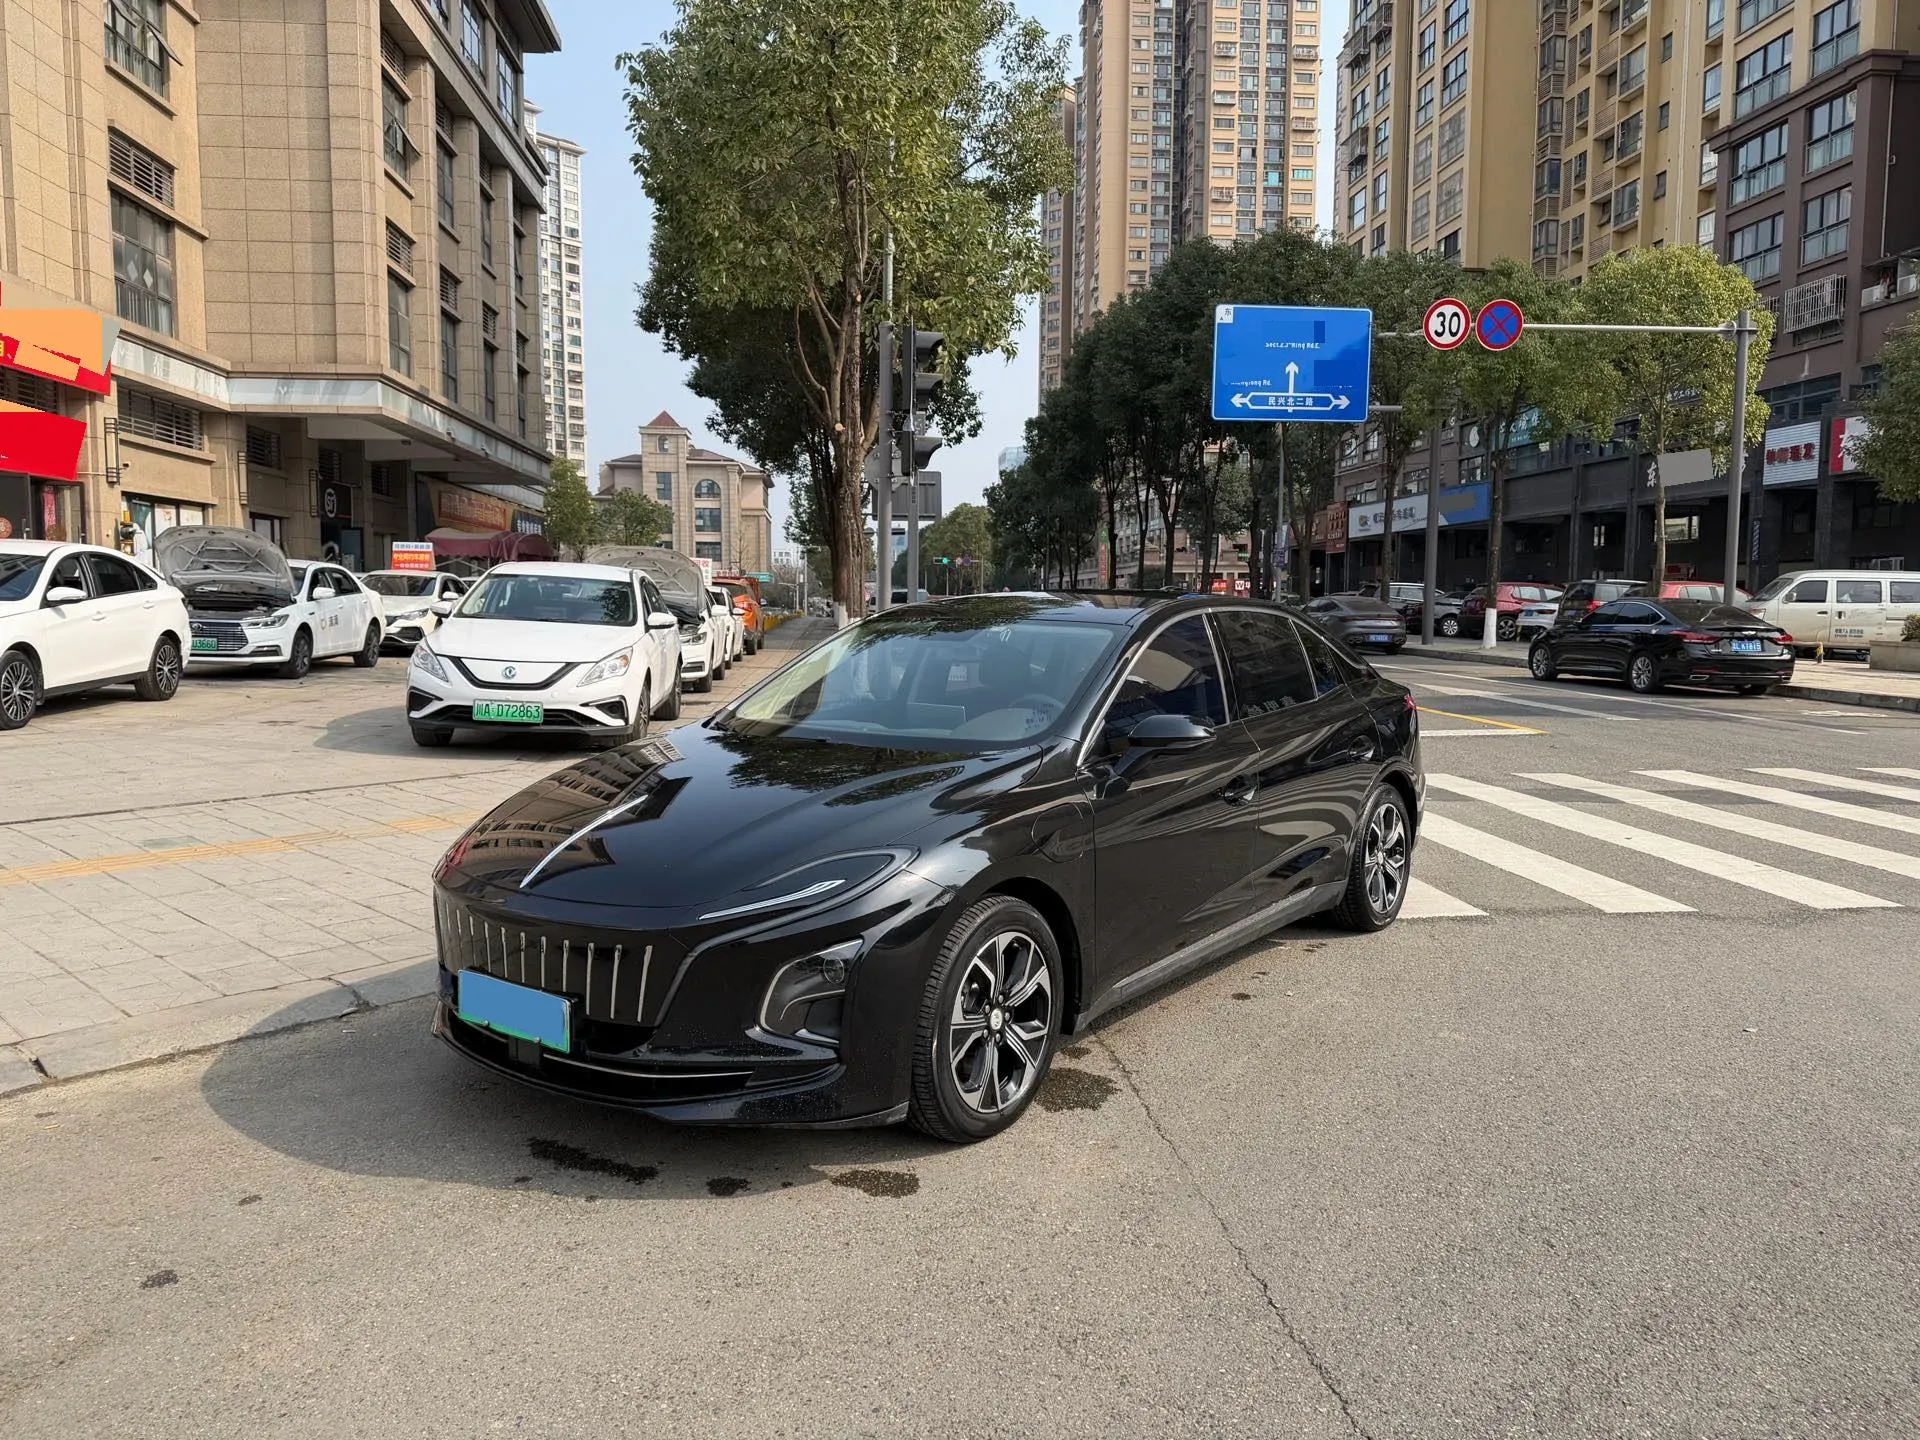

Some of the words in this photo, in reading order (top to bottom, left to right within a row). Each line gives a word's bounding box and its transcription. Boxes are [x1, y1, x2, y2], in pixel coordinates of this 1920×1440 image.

[1224, 307, 1232, 316] 东
[1434, 311, 1461, 337] 30
[1268, 396, 1314, 407] 民兴北二路
